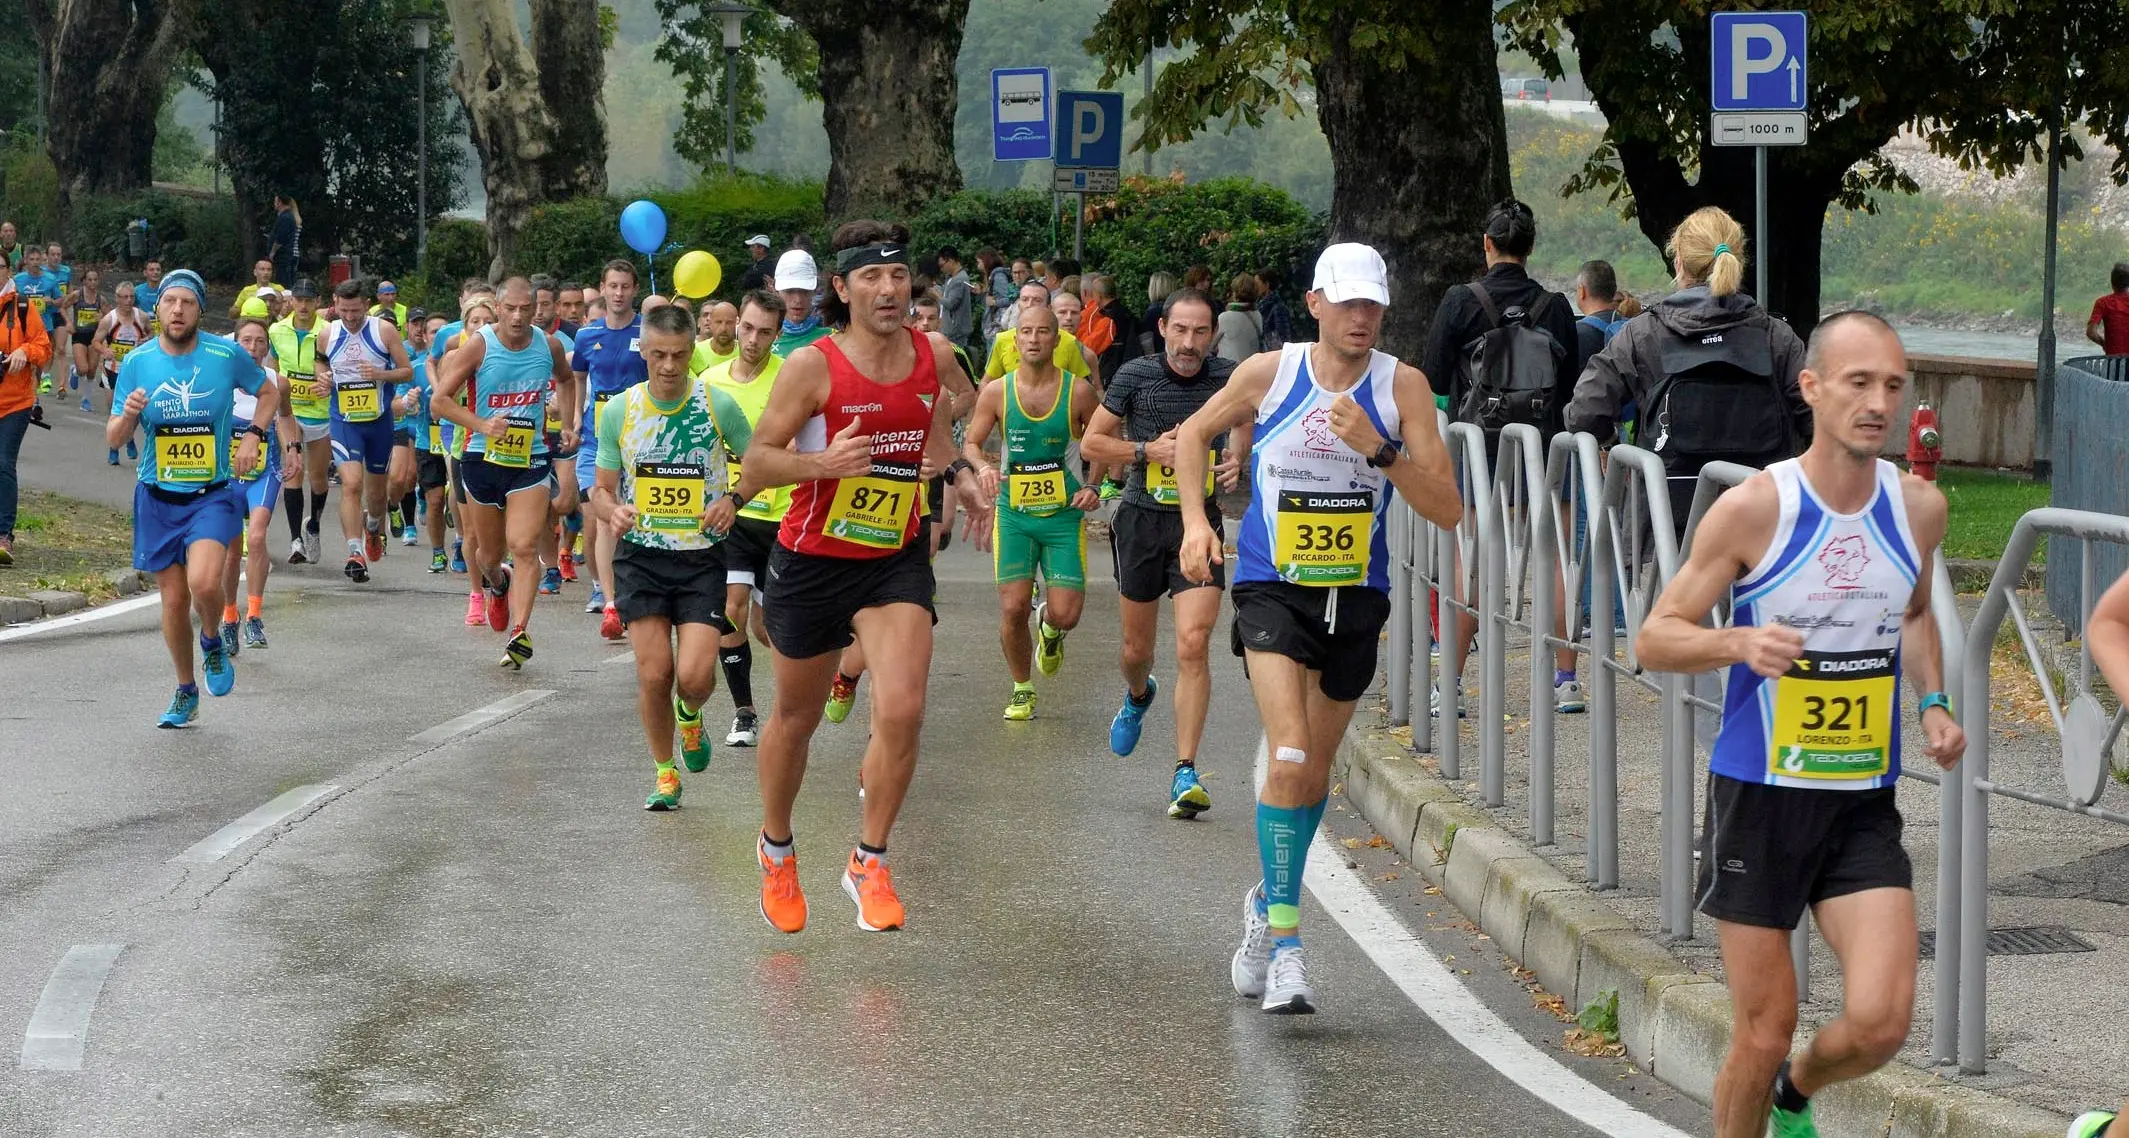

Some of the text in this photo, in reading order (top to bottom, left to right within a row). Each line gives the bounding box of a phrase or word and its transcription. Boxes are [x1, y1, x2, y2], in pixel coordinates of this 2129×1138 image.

[1732, 23, 1787, 100] P
[1071, 100, 1105, 159] P
[1750, 124, 1794, 134] 1000 m
[154, 398, 182, 408] TRENTO
[347, 395, 369, 407] 317
[163, 405, 182, 413] HALF
[841, 403, 883, 414] macron
[163, 410, 210, 420] MARATHON
[504, 418, 533, 427] IADORA
[173, 426, 210, 434] DIADORA
[167, 443, 205, 459] 440
[870, 440, 922, 456] unners
[656, 467, 700, 476] DIADORA
[871, 463, 918, 477] DIADORA
[1024, 462, 1059, 472] DIADORA
[1020, 479, 1055, 498] 738
[648, 486, 691, 507] 359
[850, 486, 901, 517] 871
[1308, 498, 1367, 508] DIADORA
[645, 507, 679, 515] GRAZIANO
[846, 511, 882, 524] GABRIELE
[1295, 524, 1354, 551] 336
[1292, 553, 1336, 562] RICCARDO
[1342, 553, 1355, 561] ITA
[1819, 657, 1889, 672] DIADORA
[1801, 695, 1869, 731] 321
[1796, 734, 1850, 745] LORENZO
